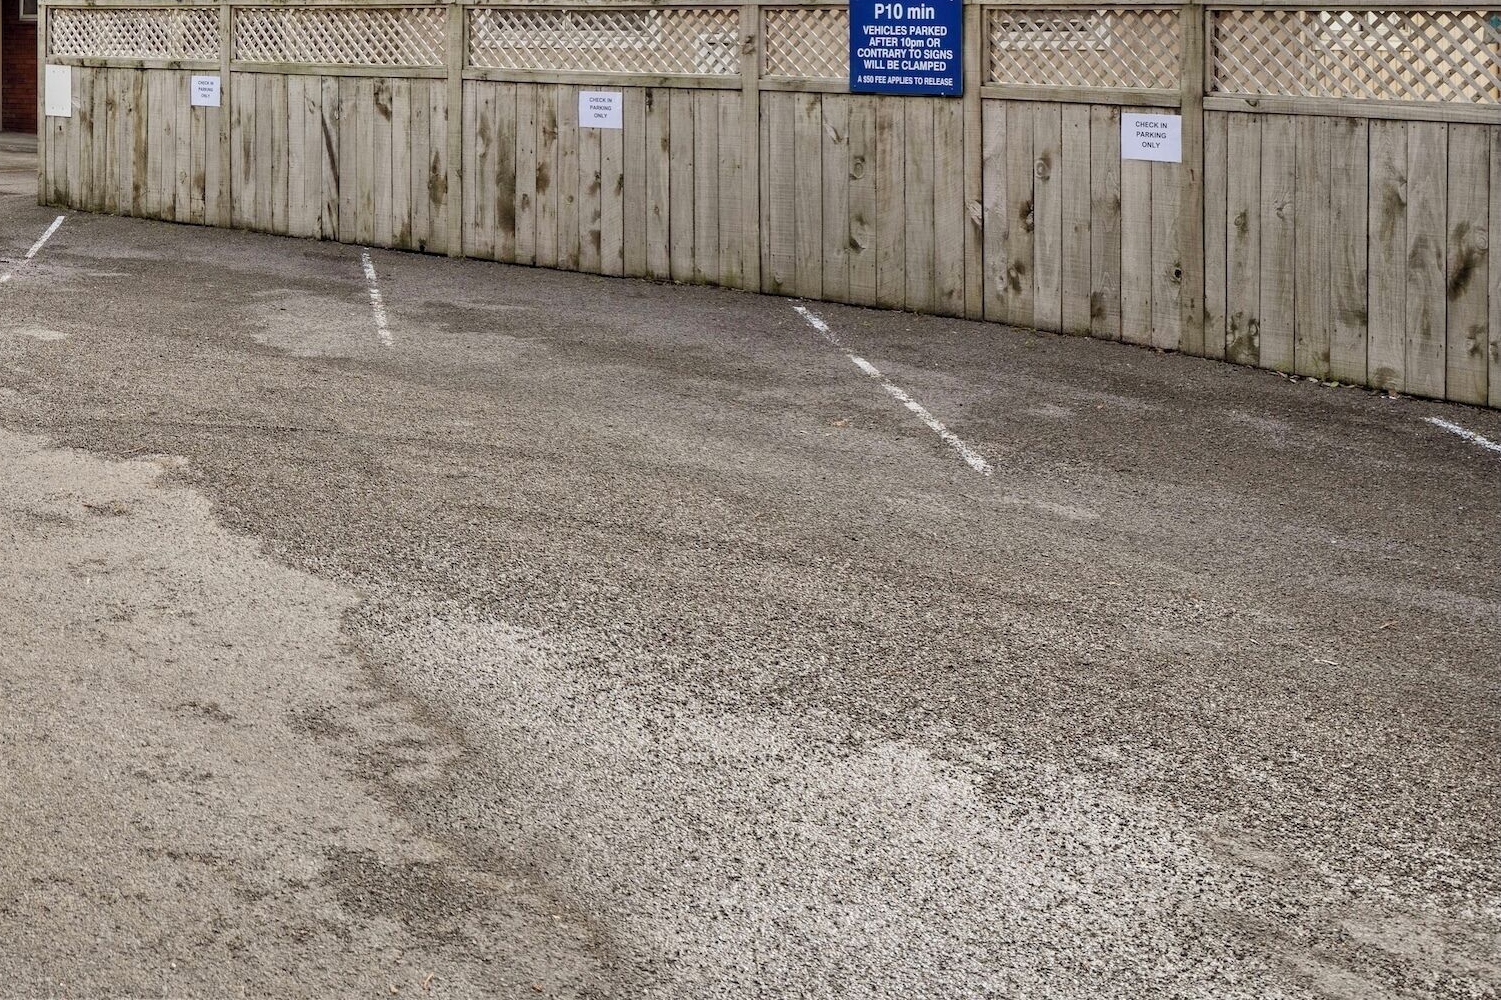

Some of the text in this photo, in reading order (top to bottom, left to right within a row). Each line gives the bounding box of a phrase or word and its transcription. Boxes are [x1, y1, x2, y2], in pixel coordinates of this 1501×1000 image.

[875, 3, 935, 19] P10 min
[863, 25, 947, 36] VEHICLES PARKED
[869, 37, 941, 49] AFTER 10pm OR
[857, 48, 953, 60] CONTRARY TO SIGNS
[863, 59, 947, 71] WILL BE CLAMPED
[857, 75, 953, 86] A $50 FEE APPLIES TO RELEASE
[1136, 131, 1167, 139] PARKING
